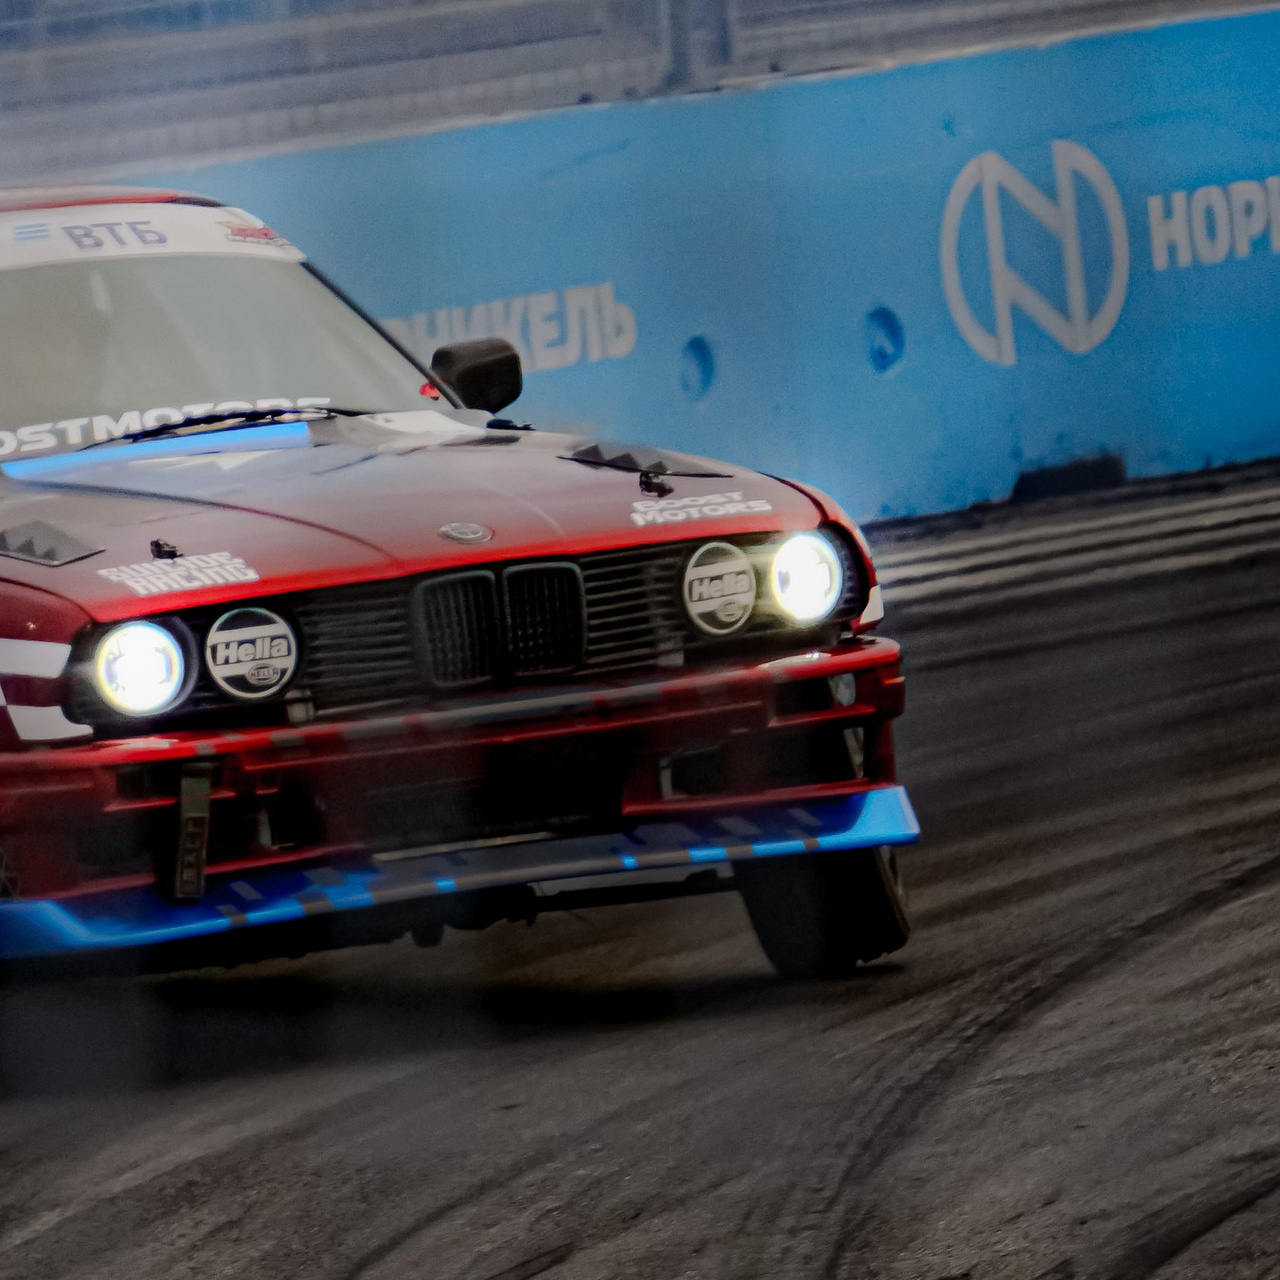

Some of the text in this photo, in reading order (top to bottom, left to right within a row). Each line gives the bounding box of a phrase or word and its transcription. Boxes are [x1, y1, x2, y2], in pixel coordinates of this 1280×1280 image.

[60, 220, 167, 250] ВТБ
[630, 499, 773, 526] MOTORS
[632, 491, 742, 512] BOOST
[123, 563, 261, 596] RACING
[691, 572, 749, 602] Hella
[216, 636, 289, 665] Hella
